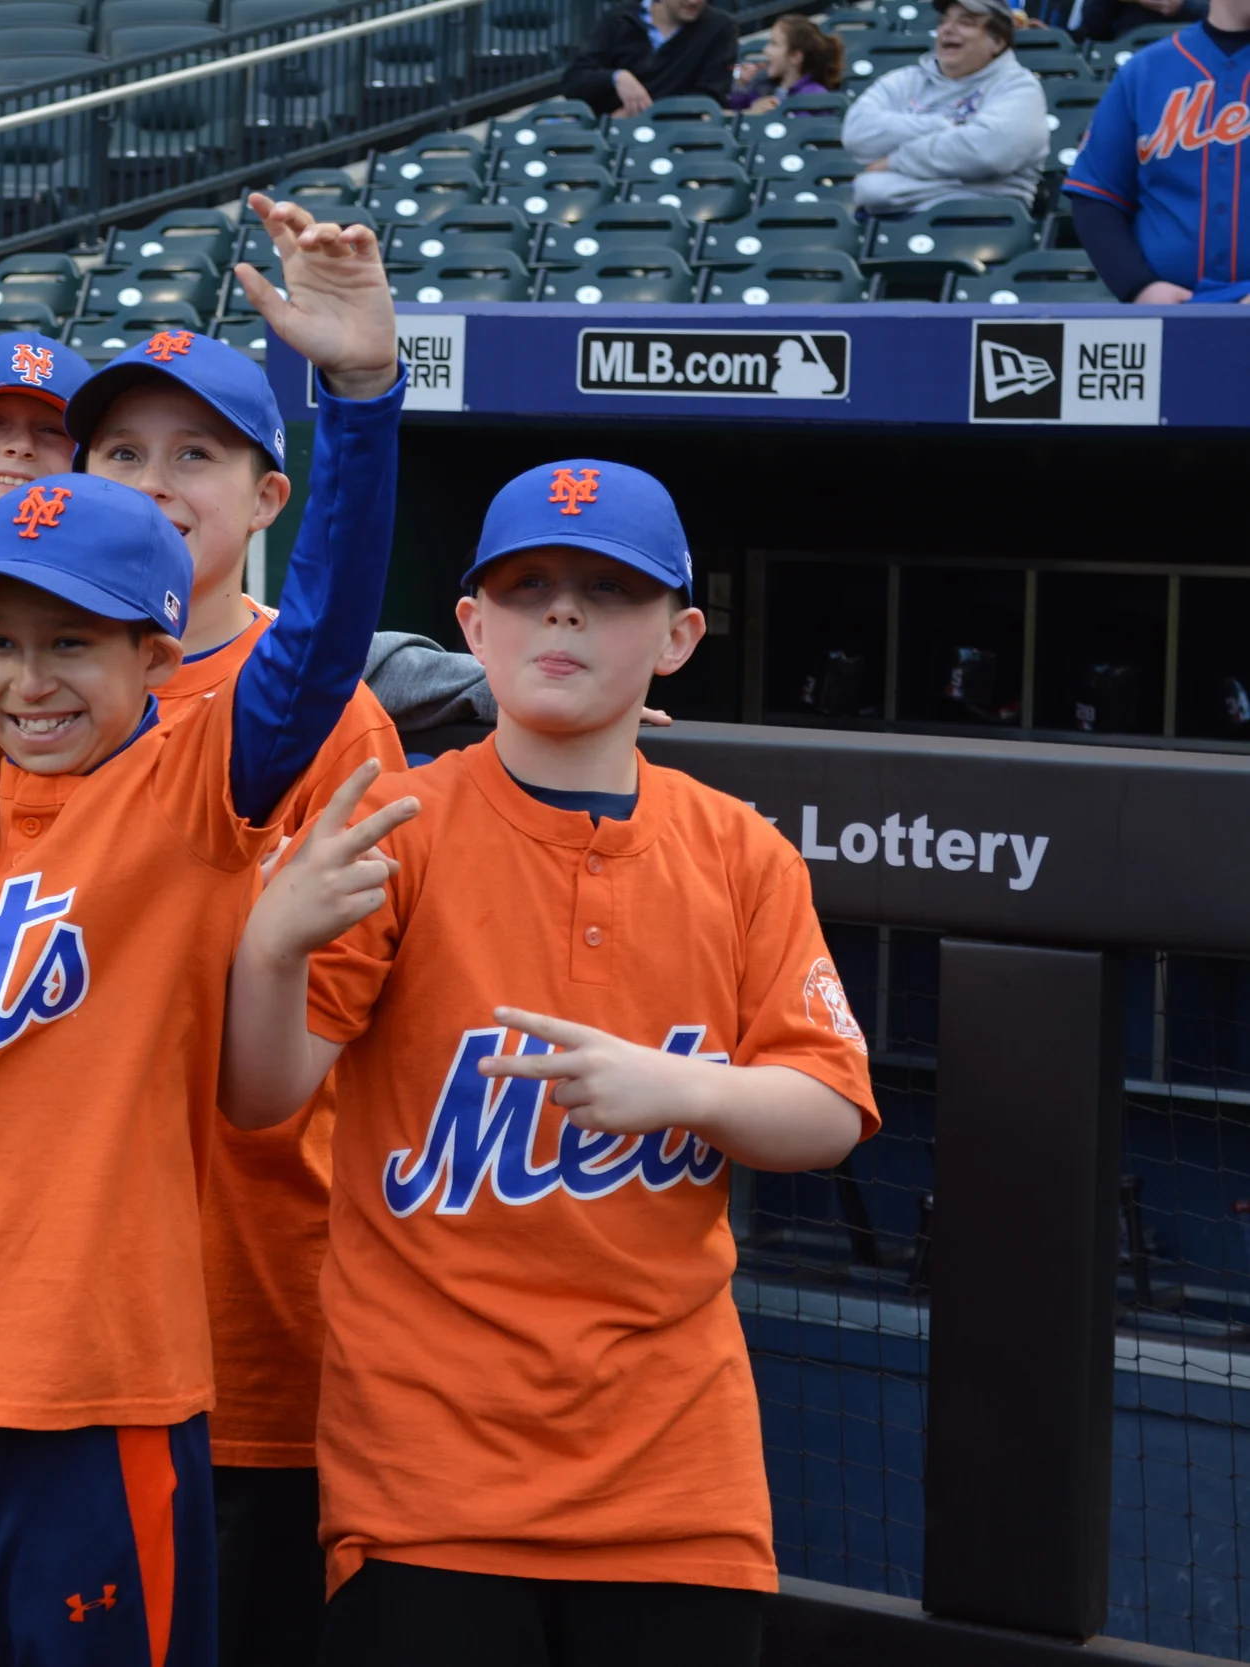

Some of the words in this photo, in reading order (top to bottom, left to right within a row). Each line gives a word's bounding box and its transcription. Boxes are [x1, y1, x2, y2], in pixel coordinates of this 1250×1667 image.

[1137, 79, 1250, 165] Me
[397, 336, 452, 361] NEW
[588, 340, 768, 386] MLB.com
[1078, 342, 1147, 371] NEW
[1078, 373, 1145, 401] ERA
[801, 804, 1050, 891] Lottery
